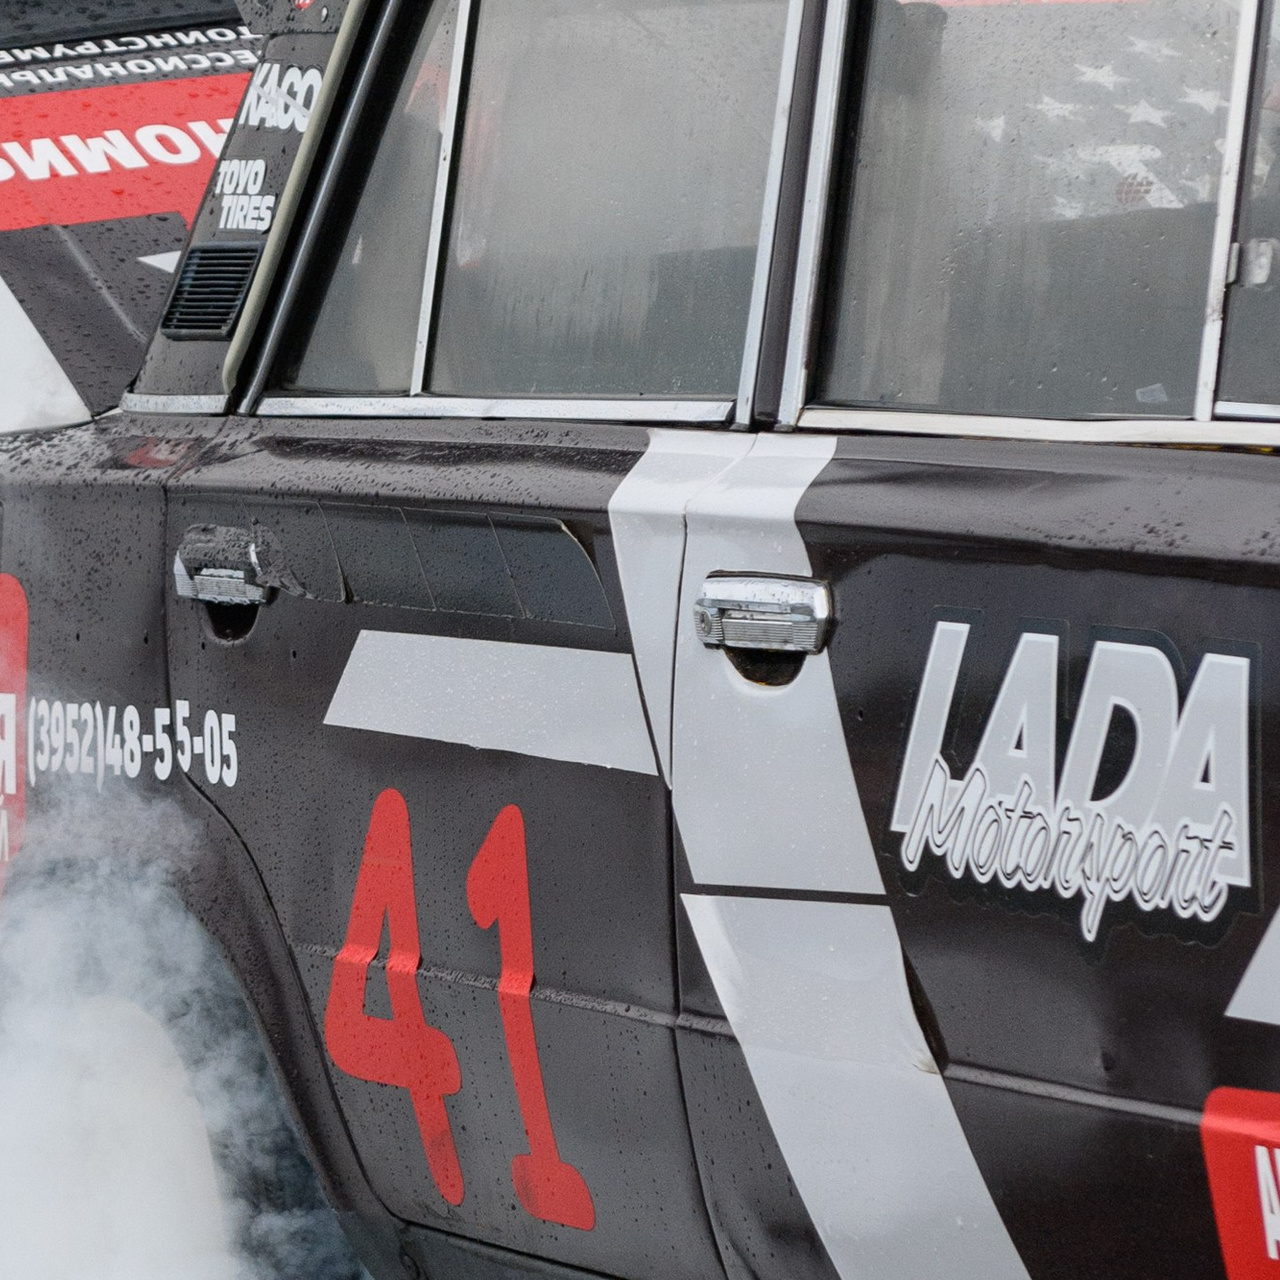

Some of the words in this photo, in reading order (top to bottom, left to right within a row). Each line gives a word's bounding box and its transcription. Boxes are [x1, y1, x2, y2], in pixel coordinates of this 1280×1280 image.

[215, 159, 266, 195] TOYO
[219, 194, 276, 231] TIRES
[891, 621, 1251, 887] LADA
[901, 753, 1237, 942] Motorsport
[324, 787, 595, 1232] 41
